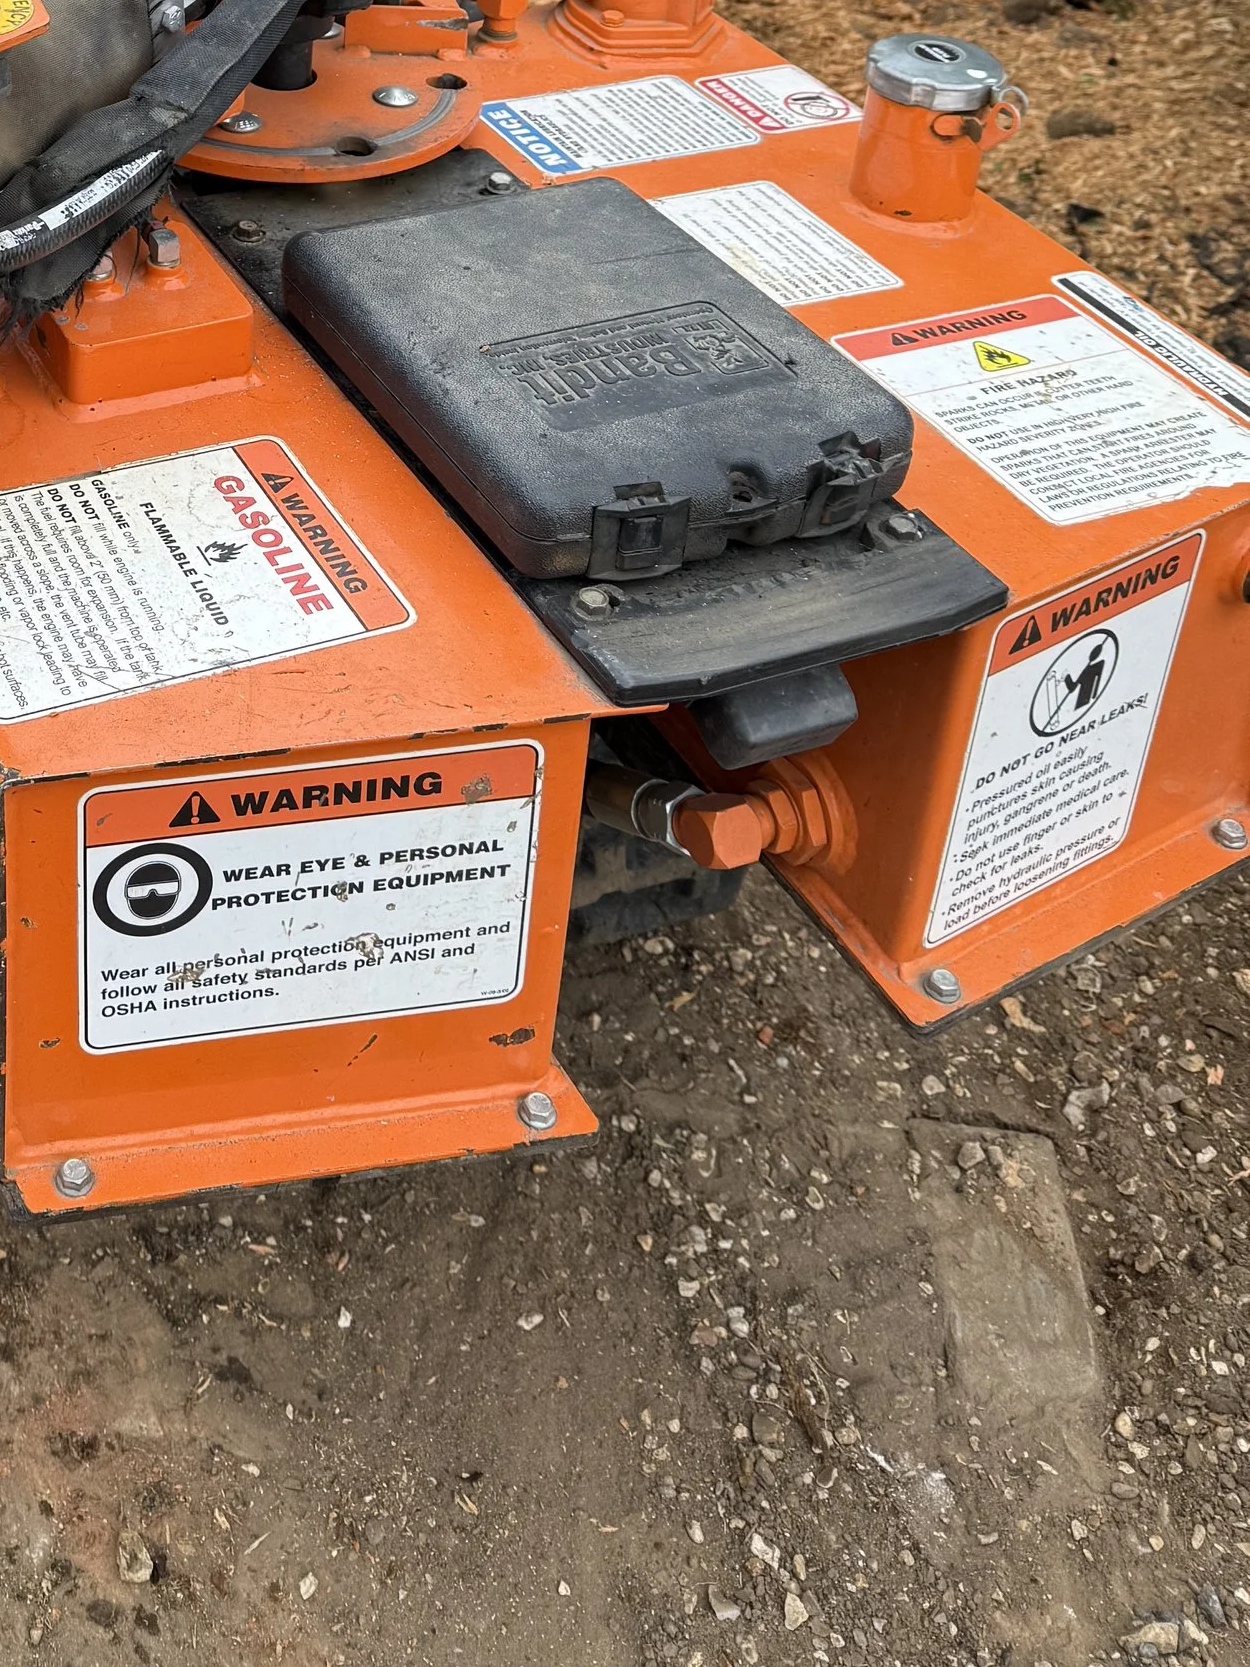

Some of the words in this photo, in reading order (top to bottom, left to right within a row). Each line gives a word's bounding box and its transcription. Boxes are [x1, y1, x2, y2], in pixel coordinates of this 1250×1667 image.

[707, 81, 762, 116] DANGER
[491, 110, 565, 165] NOTICE
[543, 332, 671, 368] INDUSTRIES,
[913, 310, 1026, 338] WARNING
[1134, 330, 1156, 345] OIL
[499, 357, 547, 377] INC.
[517, 343, 702, 406] Bandit
[980, 382, 1016, 394] FIRE
[1016, 369, 1076, 386] HAZARD
[1155, 346, 1227, 395] HYDRAULIC
[1018, 479, 1035, 487] BE
[1034, 467, 1088, 482] REQUIRED.
[1092, 461, 1115, 469] THE
[1115, 448, 1170, 464] OPERATOR
[1169, 439, 1210, 452] SHOULD
[91, 479, 129, 529] GASOLINE
[68, 483, 84, 497] DO
[78, 500, 99, 519] NOT
[91, 522, 106, 532] fill
[99, 533, 117, 555] while
[113, 557, 136, 586] engine
[131, 587, 142, 595] is
[137, 597, 164, 633] running.
[140, 502, 196, 576] FLAMMABLE
[190, 580, 228, 625] LIQUID
[214, 476, 330, 613] GASOLINE
[276, 493, 366, 592] WARNING
[31, 491, 44, 506] The
[39, 507, 56, 521] fuel
[66, 554, 84, 575] room
[79, 576, 92, 587] for
[87, 589, 117, 634] expansion.
[119, 645, 134, 660] the
[1051, 556, 1178, 630] WARNING
[975, 771, 995, 789] DO
[1000, 753, 1030, 776] NOT
[1034, 741, 1054, 758] GO
[1058, 720, 1095, 746] NEAR
[1100, 693, 1147, 725] LEAKS!
[232, 773, 441, 815] WARNING
[967, 791, 1027, 830] punctures
[1031, 777, 1055, 795] skin
[1059, 751, 1103, 780] causing
[971, 772, 1032, 812] Pressured
[1035, 762, 1050, 778] oil
[1053, 746, 1087, 769] easily
[223, 864, 290, 882] WEAR
[300, 857, 344, 873] EYE
[354, 854, 370, 867] &
[379, 840, 502, 864] PERSONAL
[955, 867, 971, 881] Do
[975, 853, 995, 871] not
[998, 842, 1019, 858] use
[1023, 821, 1057, 845] finger
[1059, 813, 1072, 825] or
[1075, 800, 1098, 817] skin
[1102, 792, 1113, 803] to
[212, 881, 363, 909] PROTECTION
[373, 864, 509, 890] EQUIPMENT
[943, 908, 970, 930] load
[973, 889, 1010, 914] before
[1013, 857, 1069, 892] loosening
[1073, 835, 1113, 860] fittings.
[947, 884, 995, 915] Remove
[999, 853, 1052, 887] hydraulic
[1055, 825, 1104, 859] pressure
[1107, 817, 1120, 828] or
[951, 872, 986, 896] check
[990, 861, 1007, 876] for
[1010, 844, 1043, 865] leaks.
[101, 968, 148, 981] Wear
[155, 961, 177, 975] all
[181, 950, 264, 977] personal
[271, 937, 366, 963] protection
[372, 927, 470, 952] equipment
[477, 921, 510, 936] and
[101, 985, 157, 999] follow
[164, 976, 187, 991] all
[191, 973, 247, 987] safety
[255, 960, 346, 980] standards
[354, 952, 383, 971] per
[390, 948, 434, 963] ANSI
[441, 943, 474, 957] and
[102, 1000, 156, 1017] OSHA
[163, 988, 278, 1009] instructions.
